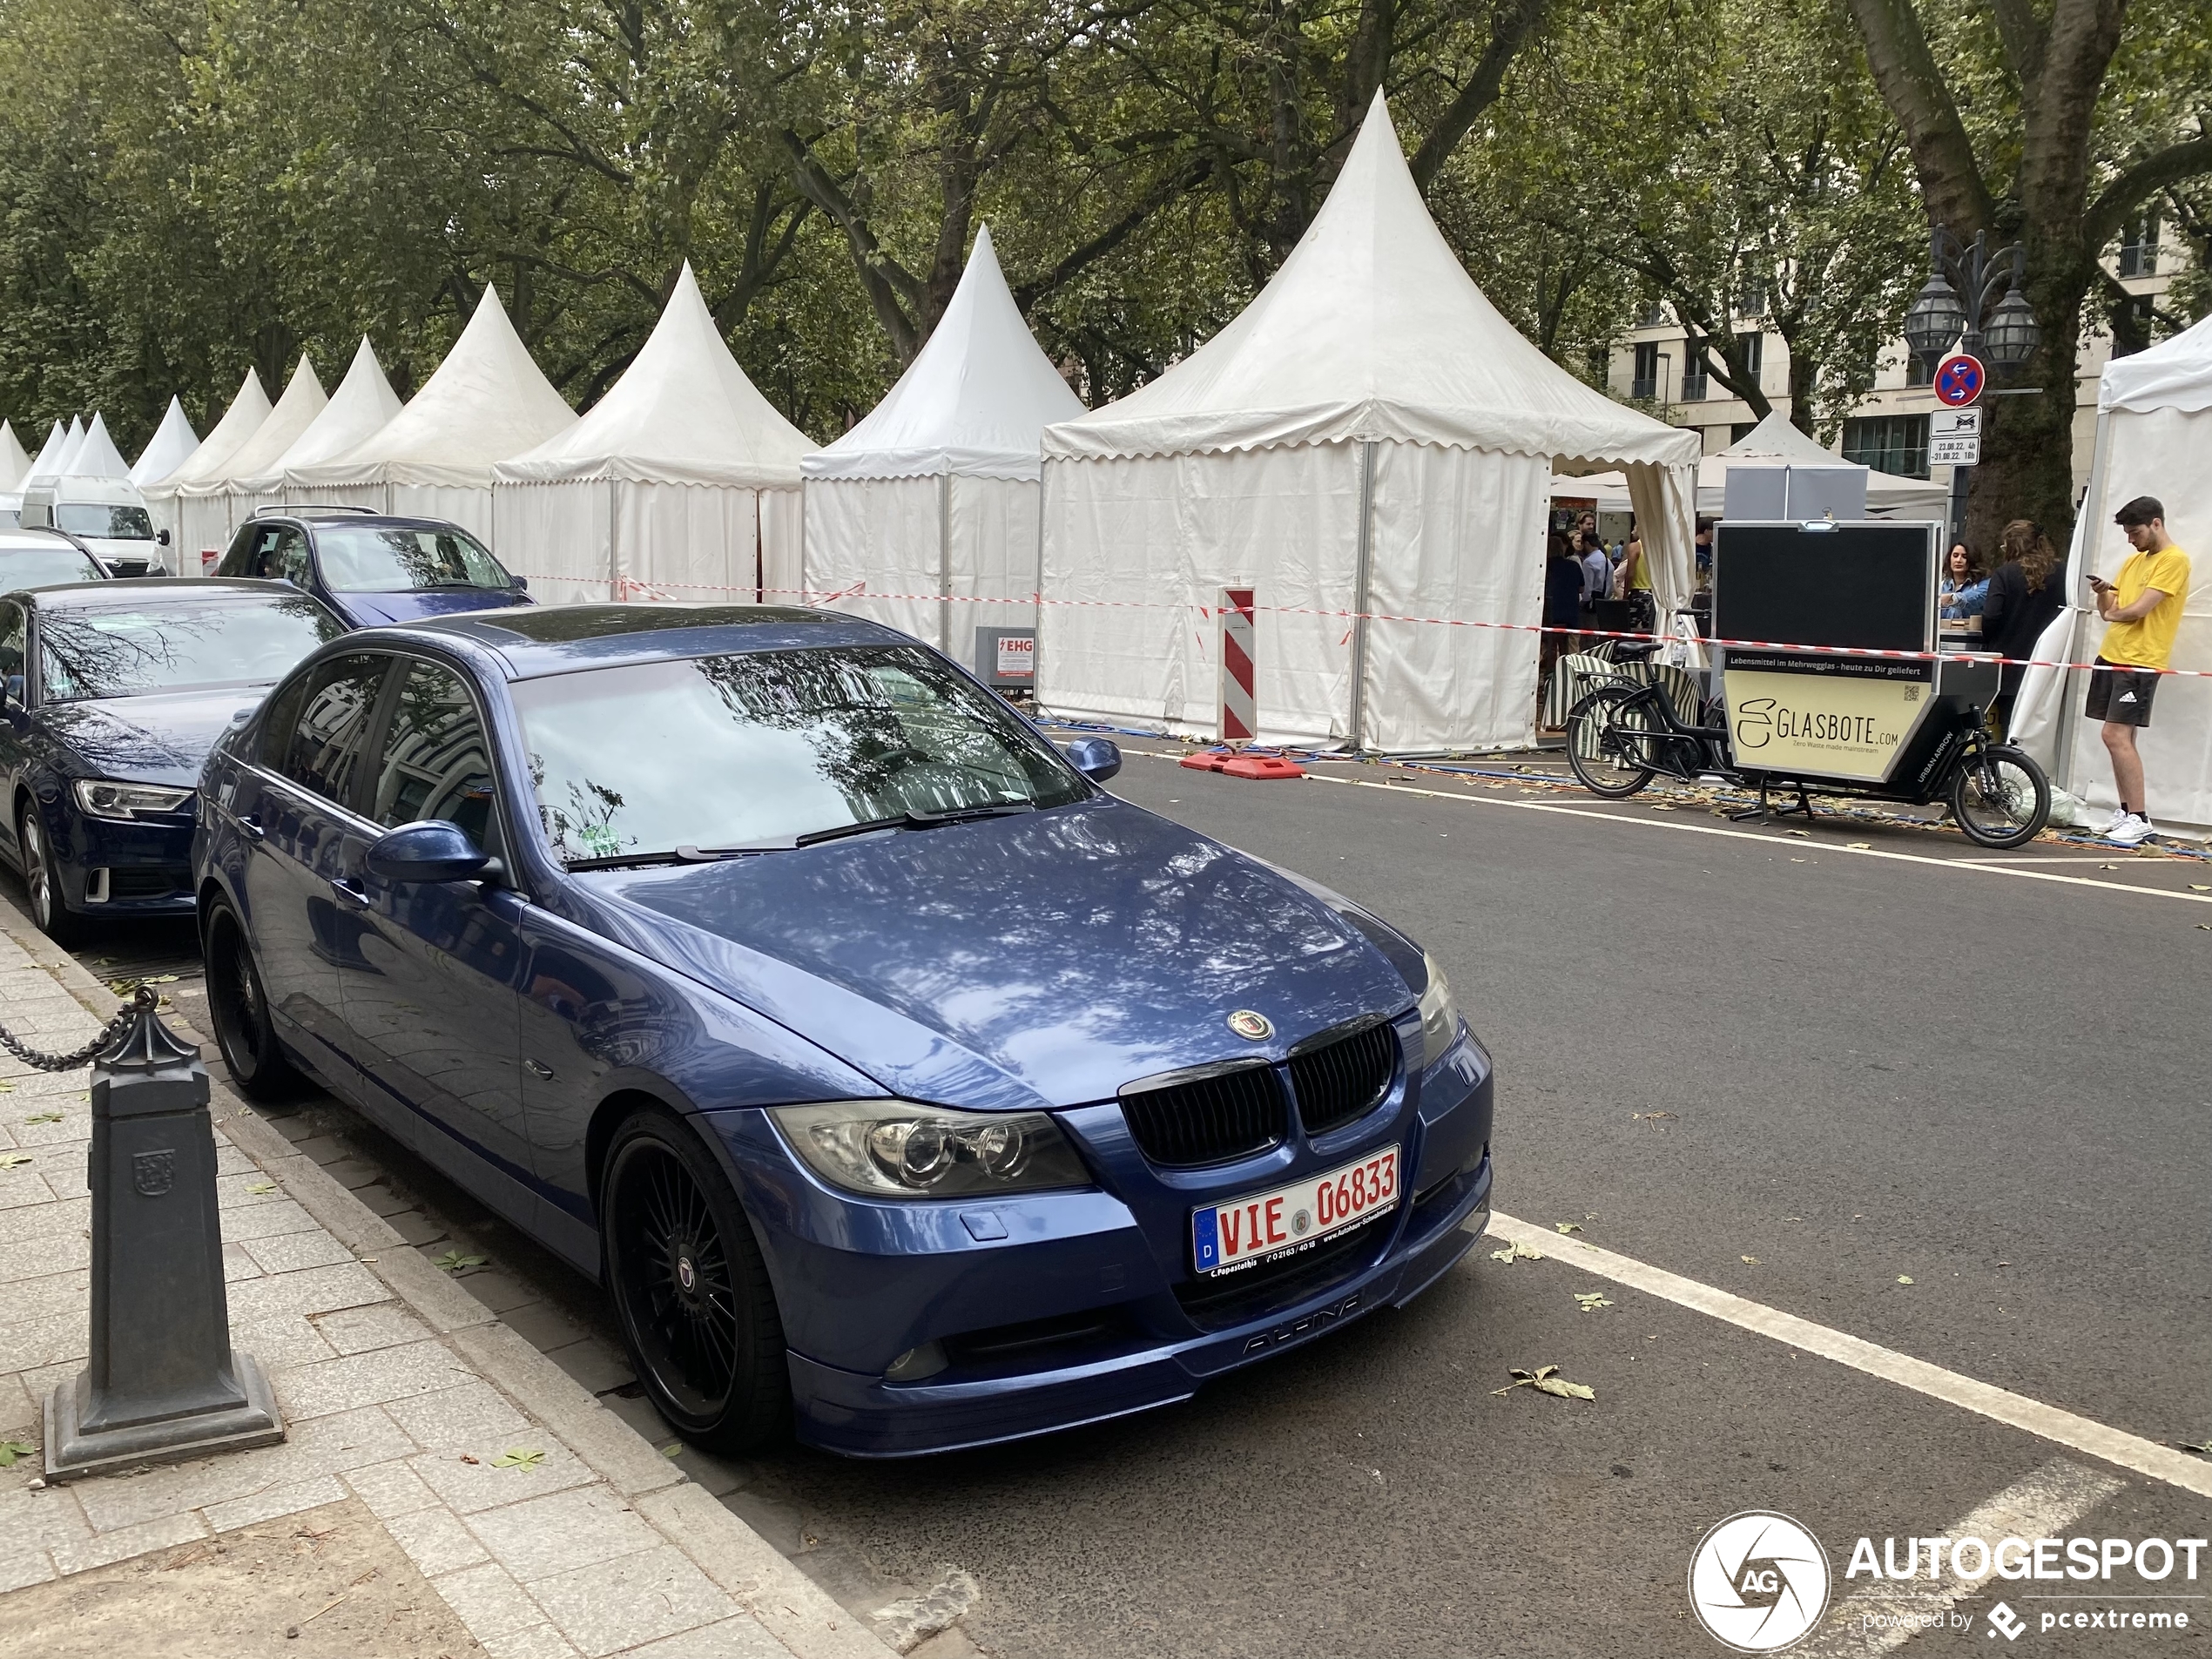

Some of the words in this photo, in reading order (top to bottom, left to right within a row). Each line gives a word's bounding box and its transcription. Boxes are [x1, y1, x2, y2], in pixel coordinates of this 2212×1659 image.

[1007, 640, 1033, 651] EHG
[1730, 657, 1776, 666] Lebensmittel
[1788, 660, 1835, 671] Mehrwegglas
[1840, 663, 1863, 671] heute
[1874, 664, 1886, 673] Dir
[1887, 666, 1920, 676] geliefert
[1843, 745, 1878, 754] mainstream
[1918, 757, 1937, 783] URBAN
[1934, 731, 1953, 759] ARROW
[1220, 1196, 1287, 1257] VIE
[1317, 1153, 1395, 1226] 06833
[1204, 1244, 1212, 1258] D
